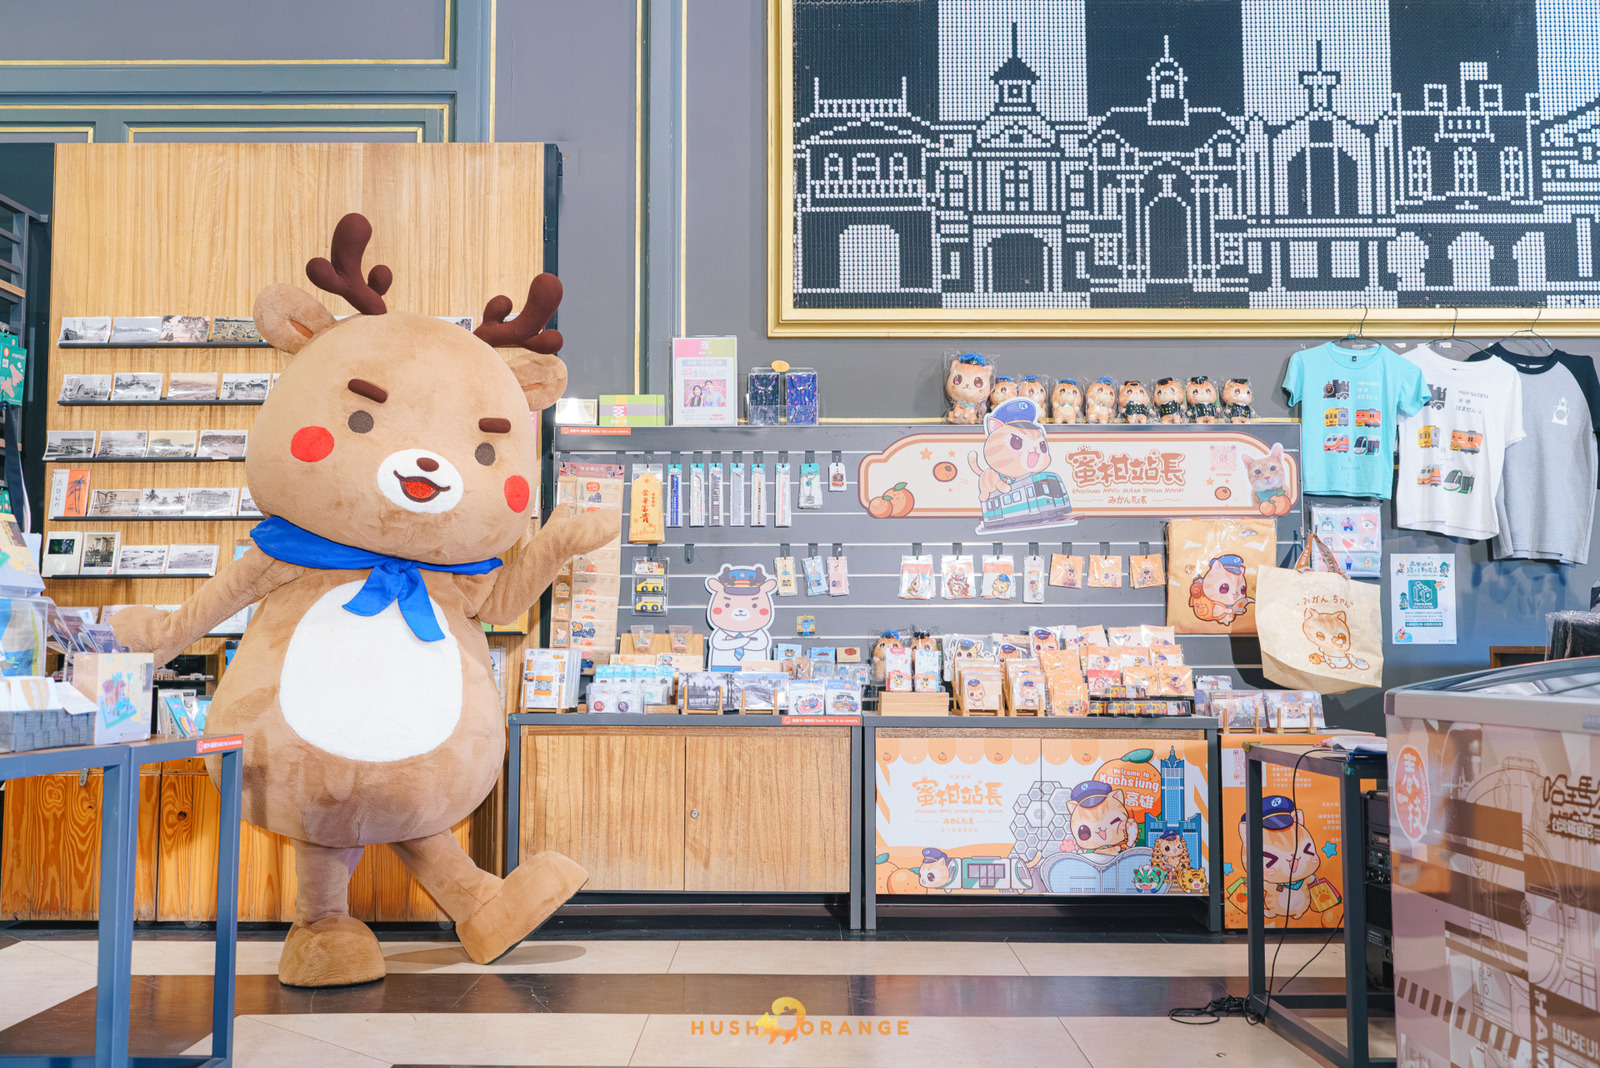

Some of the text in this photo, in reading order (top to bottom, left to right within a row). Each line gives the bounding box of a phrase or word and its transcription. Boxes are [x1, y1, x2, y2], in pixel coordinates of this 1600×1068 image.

[1066, 446, 1185, 486] 蜜柑站長
[1099, 773, 1160, 794] Kaohsiung
[1113, 768, 1140, 777] Welcome
[911, 776, 1004, 807] 蜜柑站長
[1124, 791, 1155, 809] 高雄
[1397, 752, 1427, 835] 春一枝
[1551, 1021, 1600, 1061] MUSEU
